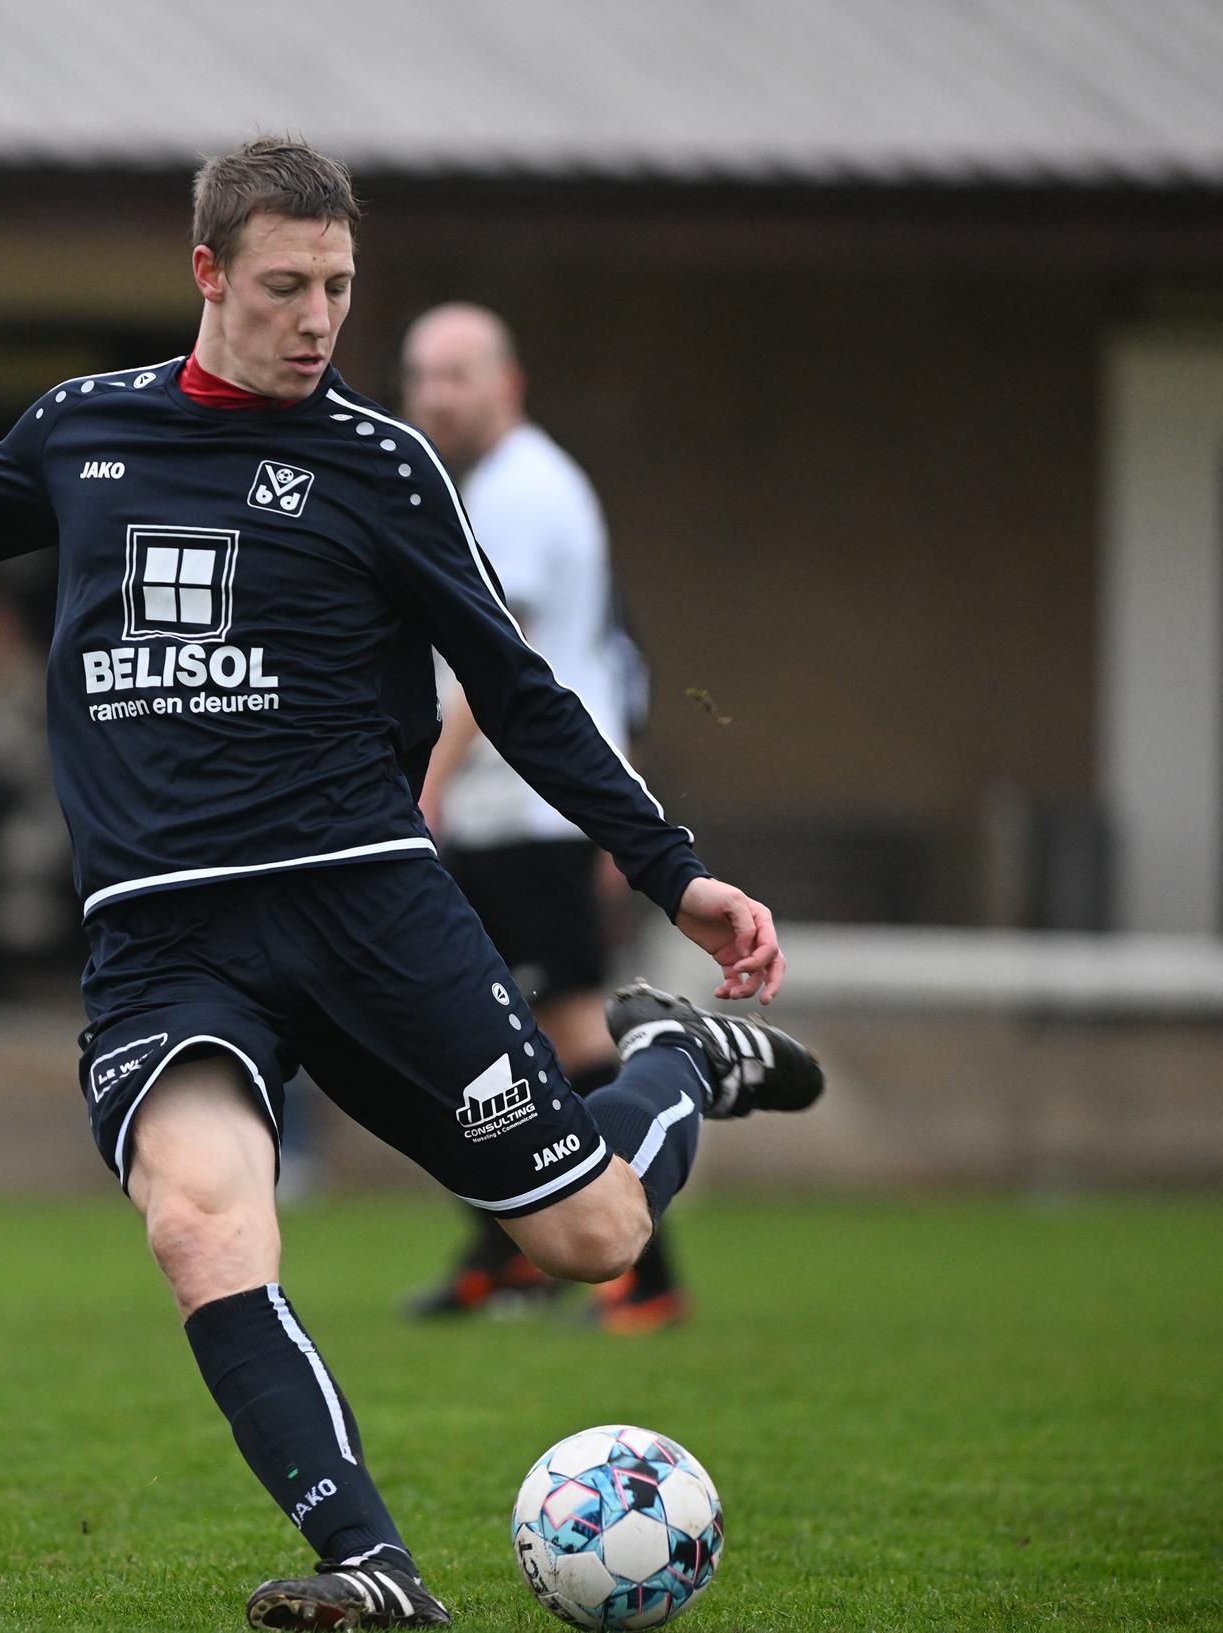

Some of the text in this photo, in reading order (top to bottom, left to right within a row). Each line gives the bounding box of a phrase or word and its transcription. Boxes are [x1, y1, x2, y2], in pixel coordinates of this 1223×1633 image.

[80, 460, 125, 480] JAKO
[82, 643, 279, 694] BELISOL
[89, 690, 279, 722] ramen en deuren
[464, 1102, 536, 1139] CONSULTING
[532, 1133, 581, 1172] JAKO
[291, 1478, 338, 1530] JAKO
